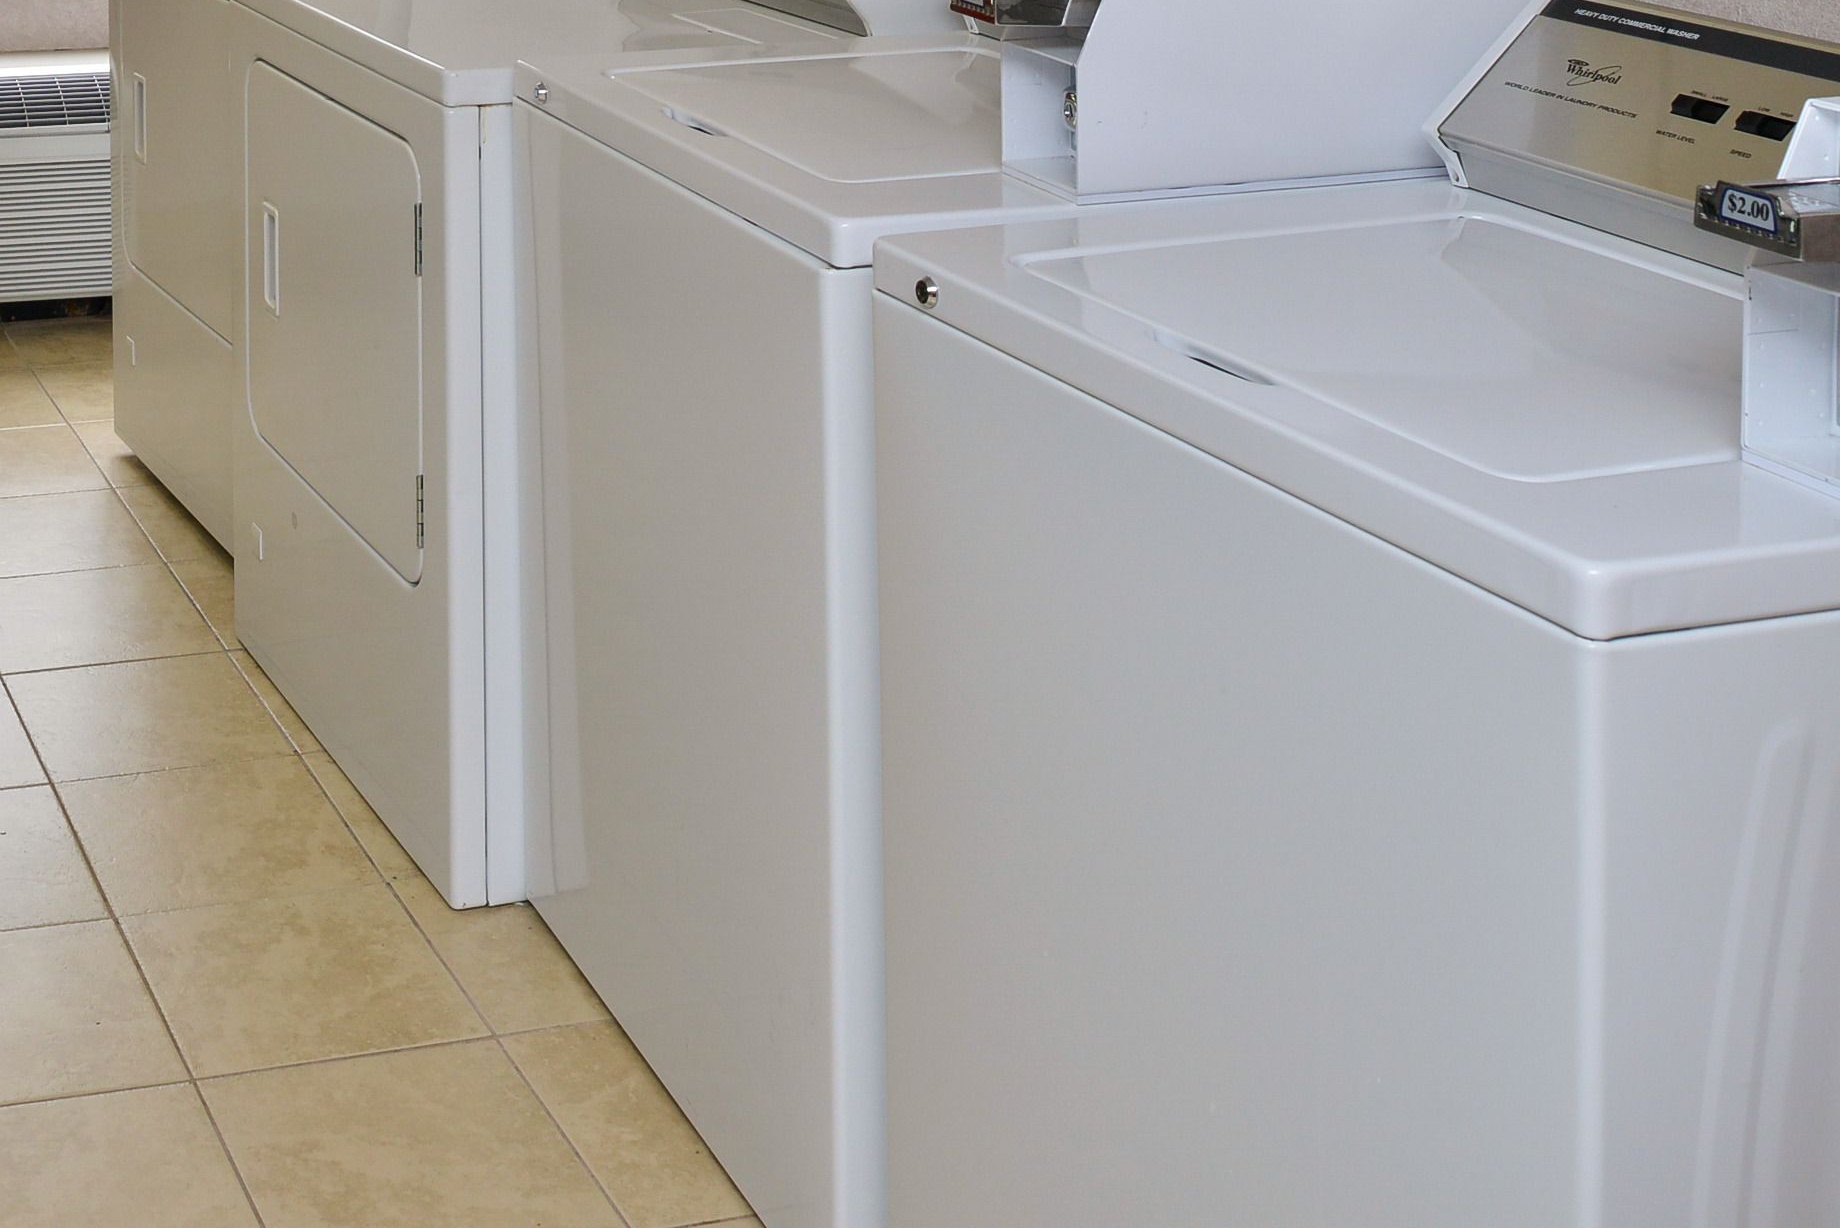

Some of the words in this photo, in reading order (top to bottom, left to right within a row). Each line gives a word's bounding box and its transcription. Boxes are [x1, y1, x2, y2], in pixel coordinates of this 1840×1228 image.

[1574, 8, 1599, 19] HEAVY
[1598, 13, 1620, 23] DUTY
[1618, 18, 1666, 33] COMMERCIAL
[1666, 28, 1701, 40] WASHER
[1566, 63, 1623, 85] Whirlpool
[1504, 81, 1529, 91] WORLD
[1529, 86, 1556, 98] LEADER
[1564, 96, 1598, 108] LAUNDRY
[1597, 105, 1638, 118] PRODUCTS
[1655, 129, 1678, 140] WATER
[1677, 135, 1696, 145] LEVEL
[1729, 148, 1752, 159] SPEED
[1727, 192, 1771, 222] $2.00
